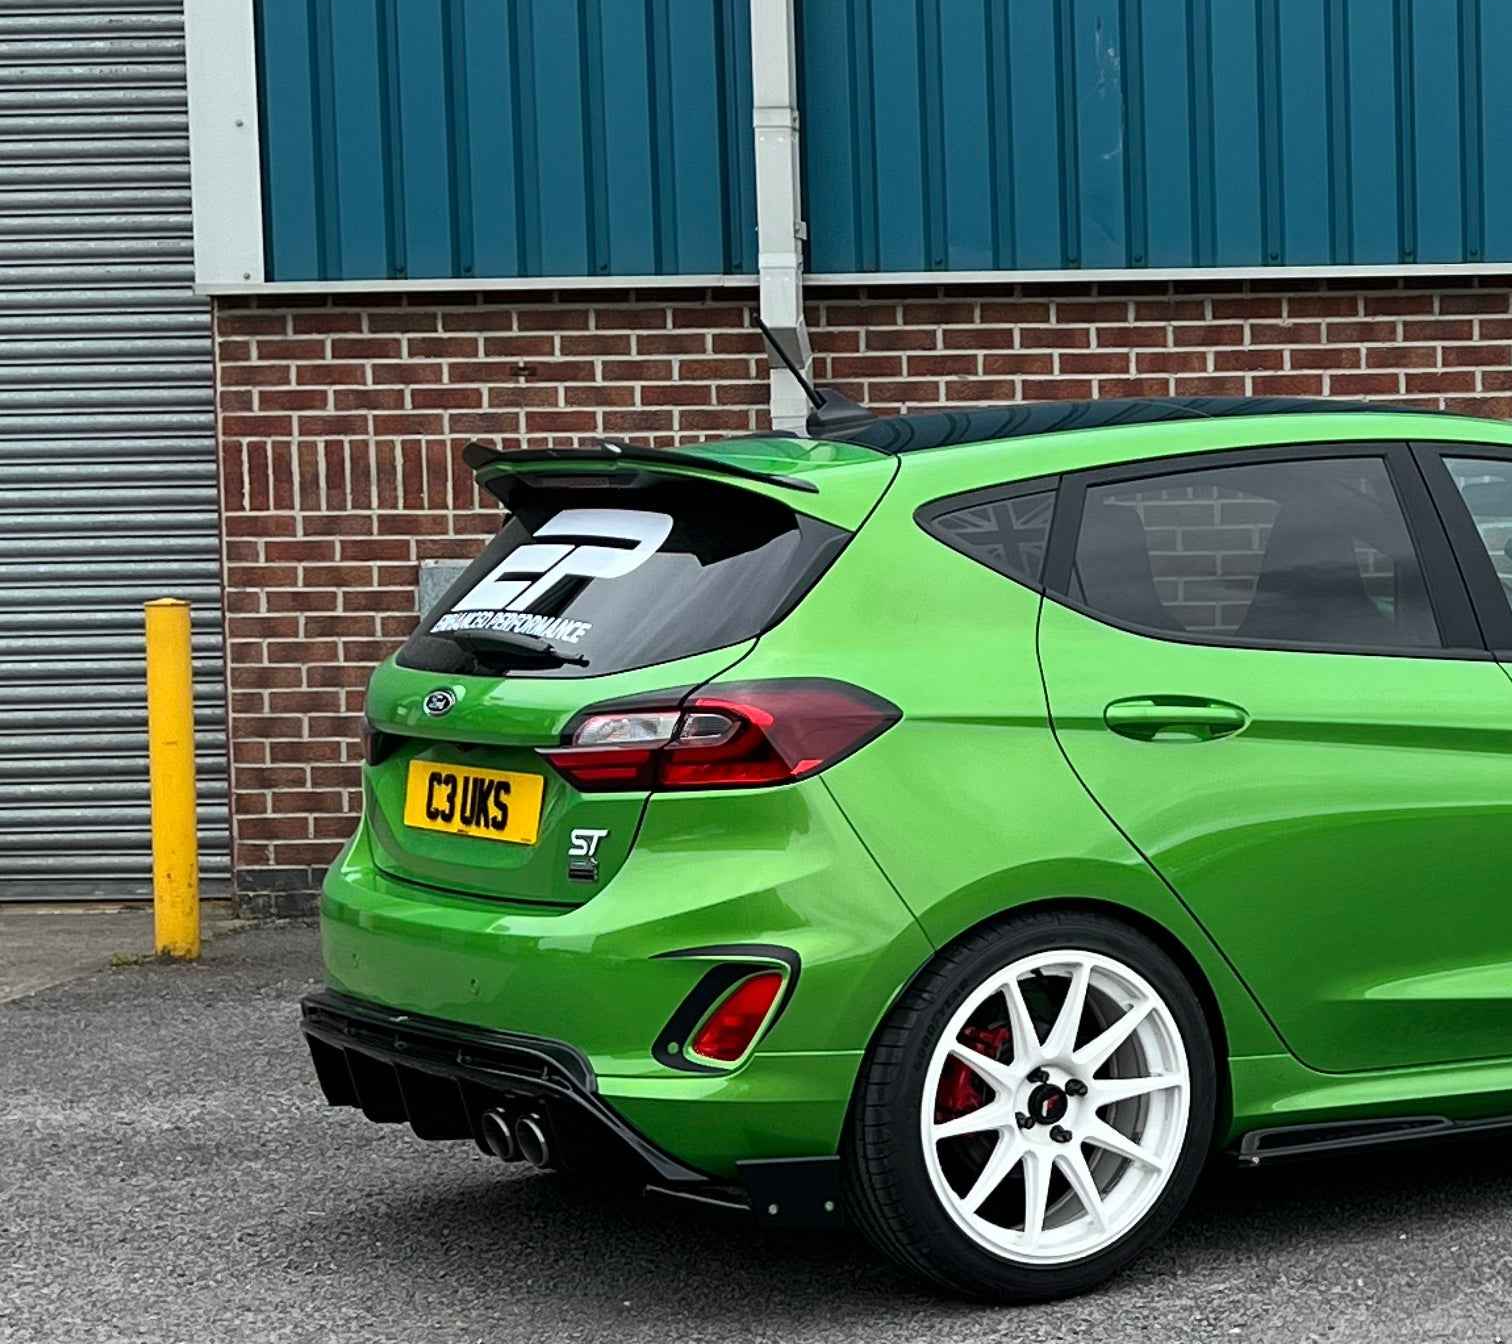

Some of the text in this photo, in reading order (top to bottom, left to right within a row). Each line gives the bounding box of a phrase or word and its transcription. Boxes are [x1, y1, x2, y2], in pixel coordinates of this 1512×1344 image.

[426, 771, 511, 832] C3 UKS
[568, 829, 608, 856] ST
